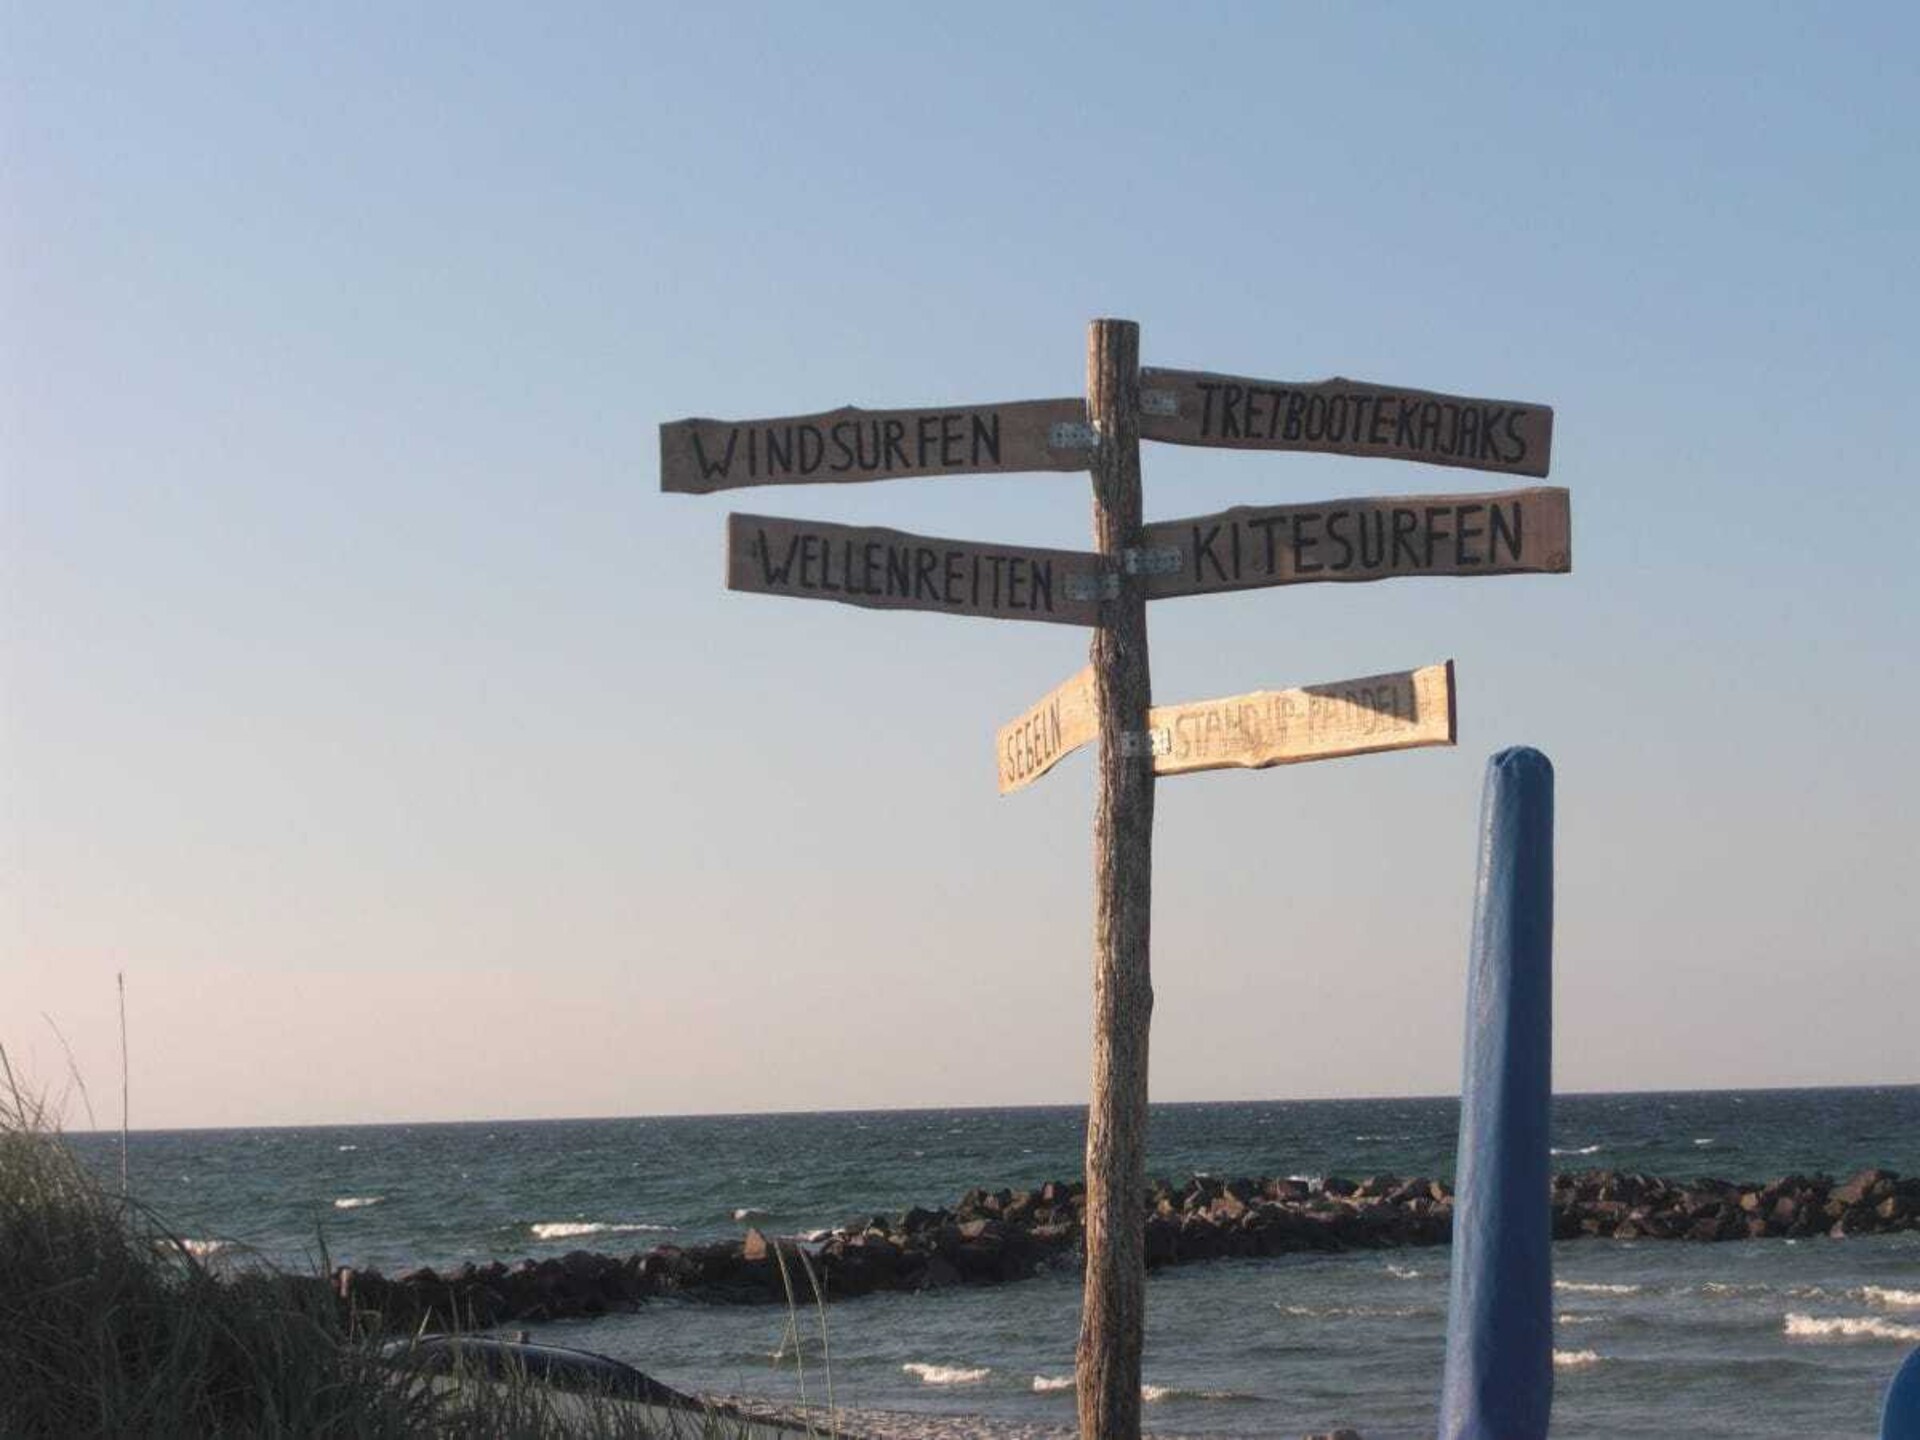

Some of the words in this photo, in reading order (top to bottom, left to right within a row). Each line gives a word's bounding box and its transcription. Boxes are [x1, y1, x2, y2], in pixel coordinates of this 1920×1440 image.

[691, 413, 999, 479] WINDSURFEN
[757, 529, 1054, 612] WELLENREITEN
[1192, 502, 1522, 582] KITESURFEN
[1007, 697, 1062, 782] SEGELN
